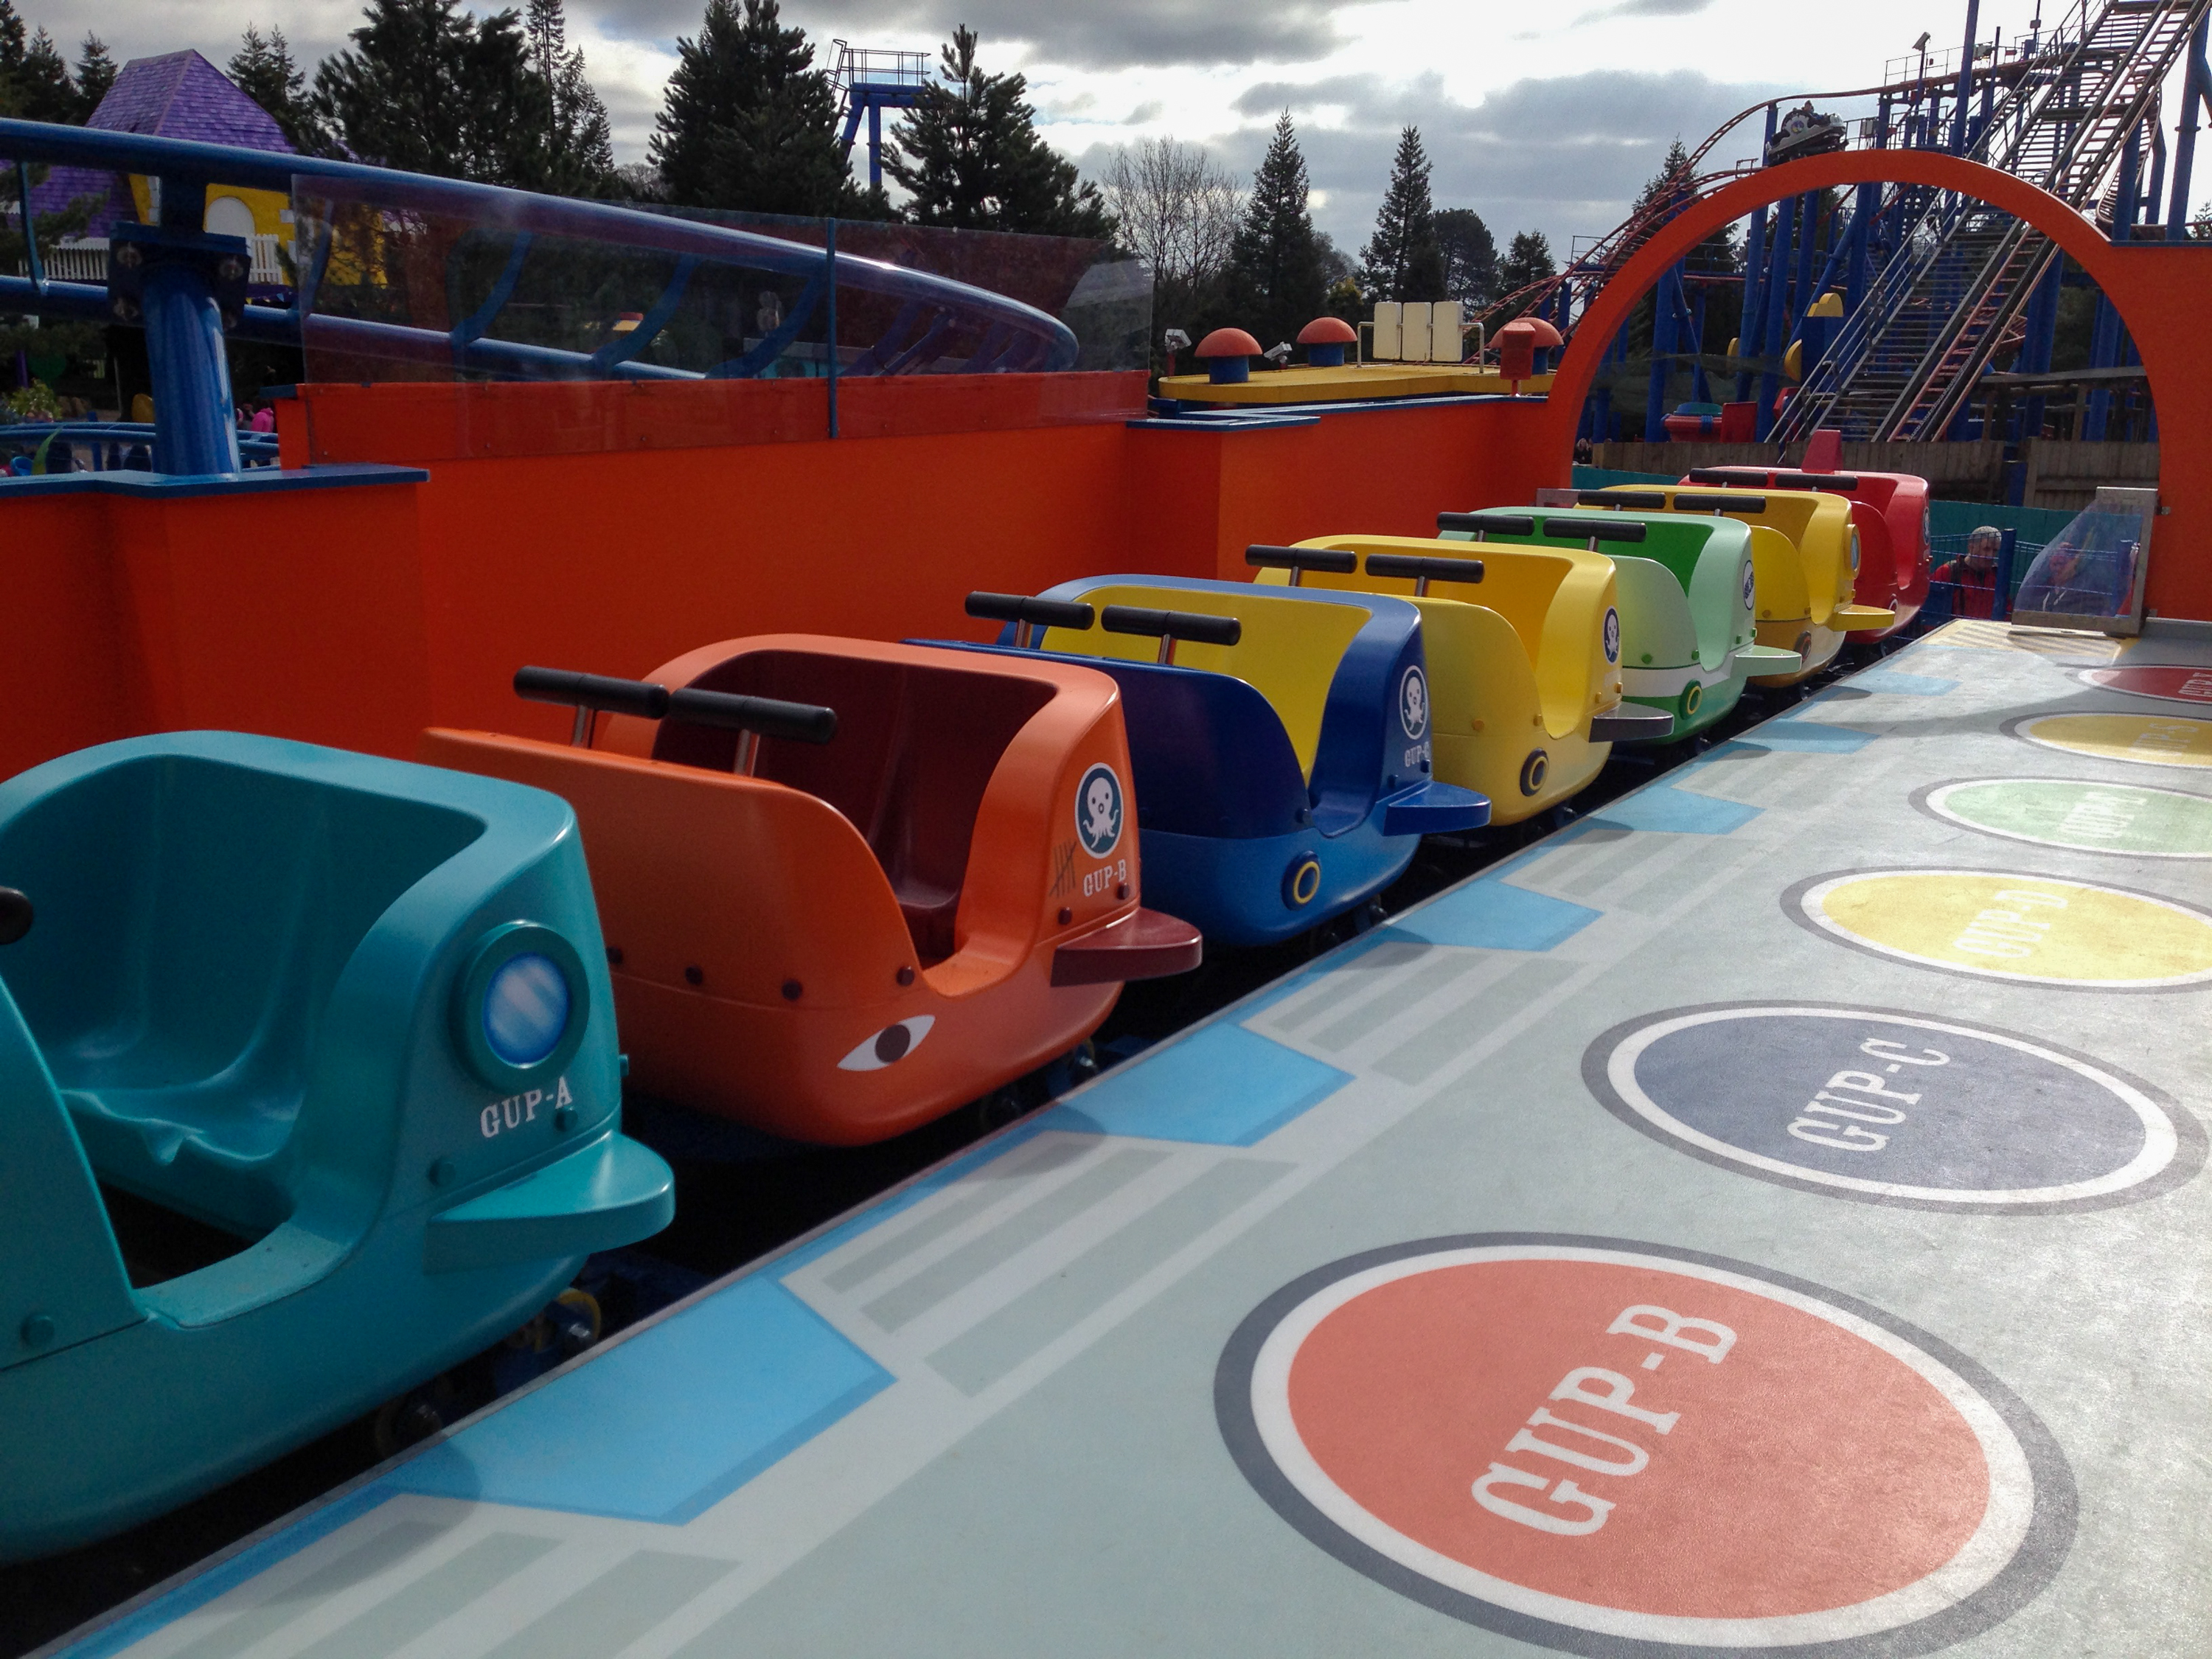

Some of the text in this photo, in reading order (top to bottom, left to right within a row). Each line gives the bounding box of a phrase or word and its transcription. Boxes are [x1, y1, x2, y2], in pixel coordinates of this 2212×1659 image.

[1083, 859, 1127, 897] GUP-B
[1952, 889, 2069, 958] GUP-D
[480, 1076, 573, 1138] GUP-A
[1787, 1037, 1951, 1152] GUP-C
[1472, 1304, 1738, 1536] GUP-B
